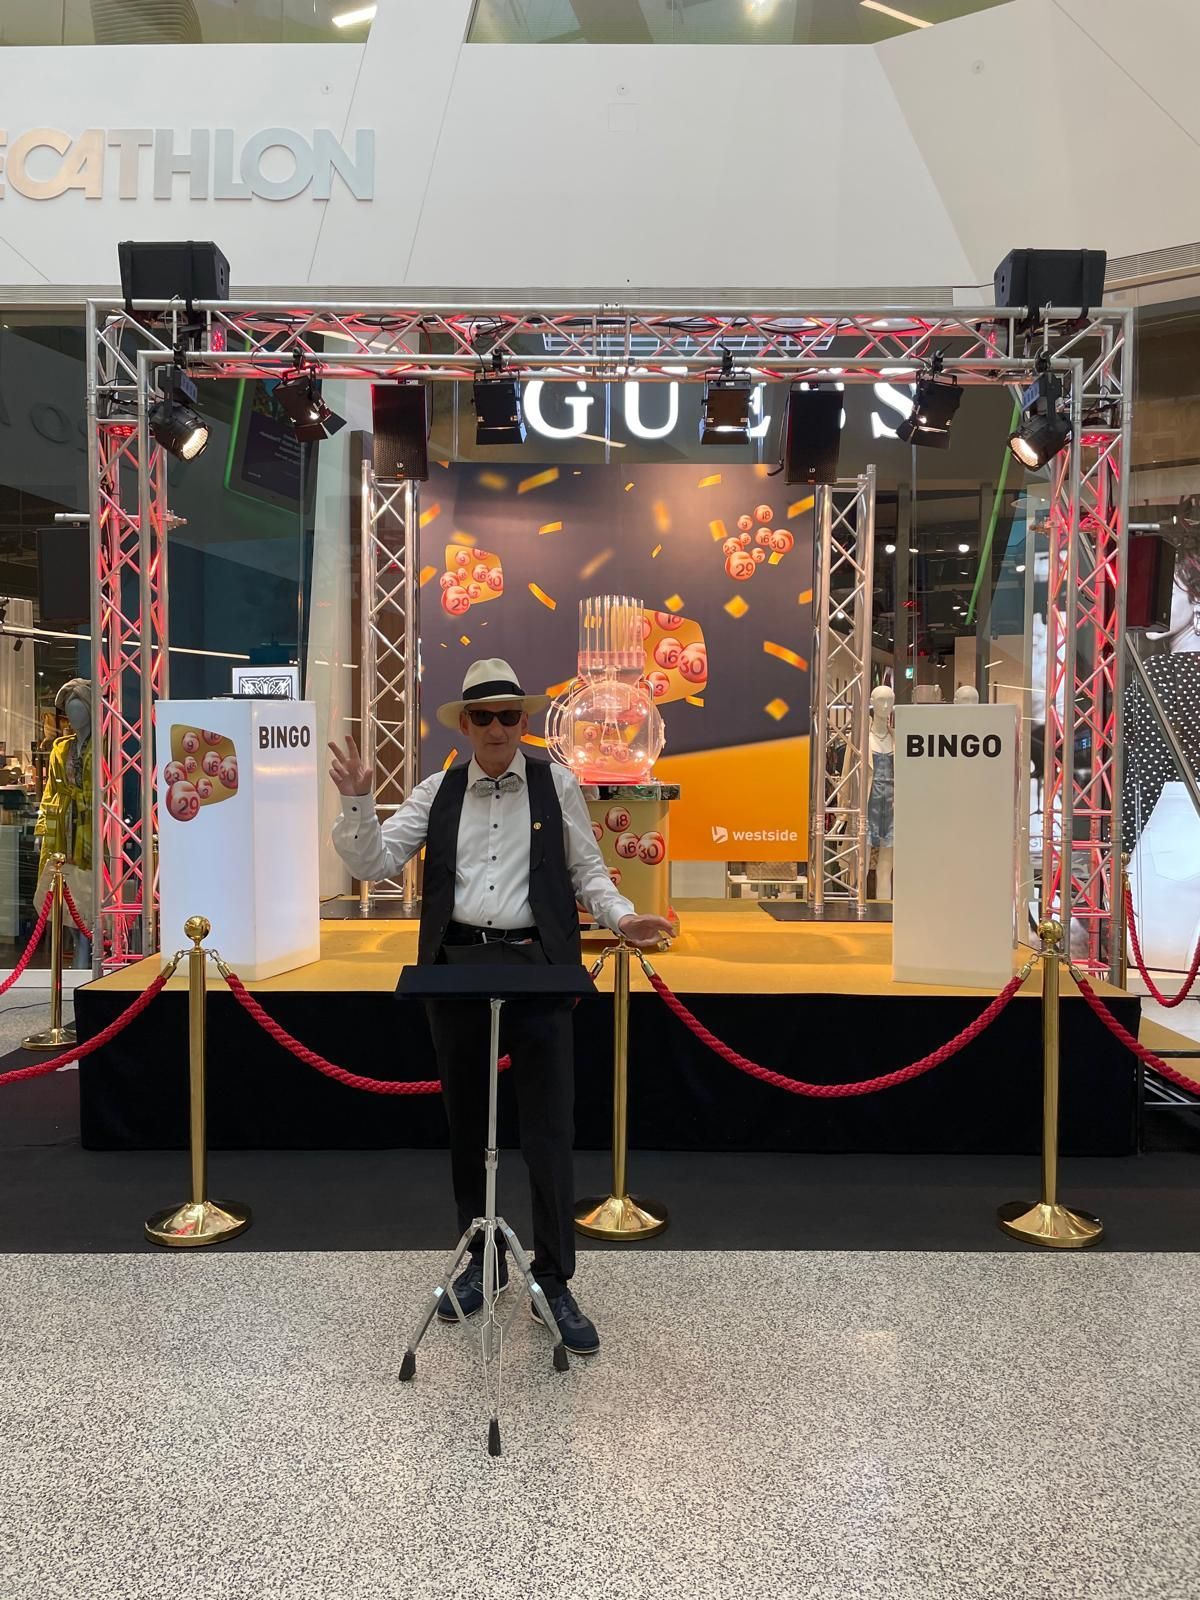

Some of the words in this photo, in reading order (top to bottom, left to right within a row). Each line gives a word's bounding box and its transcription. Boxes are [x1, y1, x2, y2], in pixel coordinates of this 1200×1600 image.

[0, 128, 375, 201] CATHLON
[762, 510, 771, 520] 18
[760, 534, 770, 544] 16
[771, 537, 786, 550] 30
[476, 570, 487, 581] 16
[735, 562, 754, 577] 29
[487, 573, 502, 587] 30
[451, 597, 470, 611] 29
[662, 649, 678, 664] 16
[680, 656, 705, 675] 30
[258, 725, 311, 749] BINGO
[906, 734, 1002, 758] BINGO
[208, 760, 219, 772] 16
[219, 766, 237, 782] 30
[177, 796, 200, 816] 29
[615, 814, 629, 827] 18
[732, 829, 798, 841] westside
[622, 841, 637, 854] 16
[638, 844, 659, 859] 30
